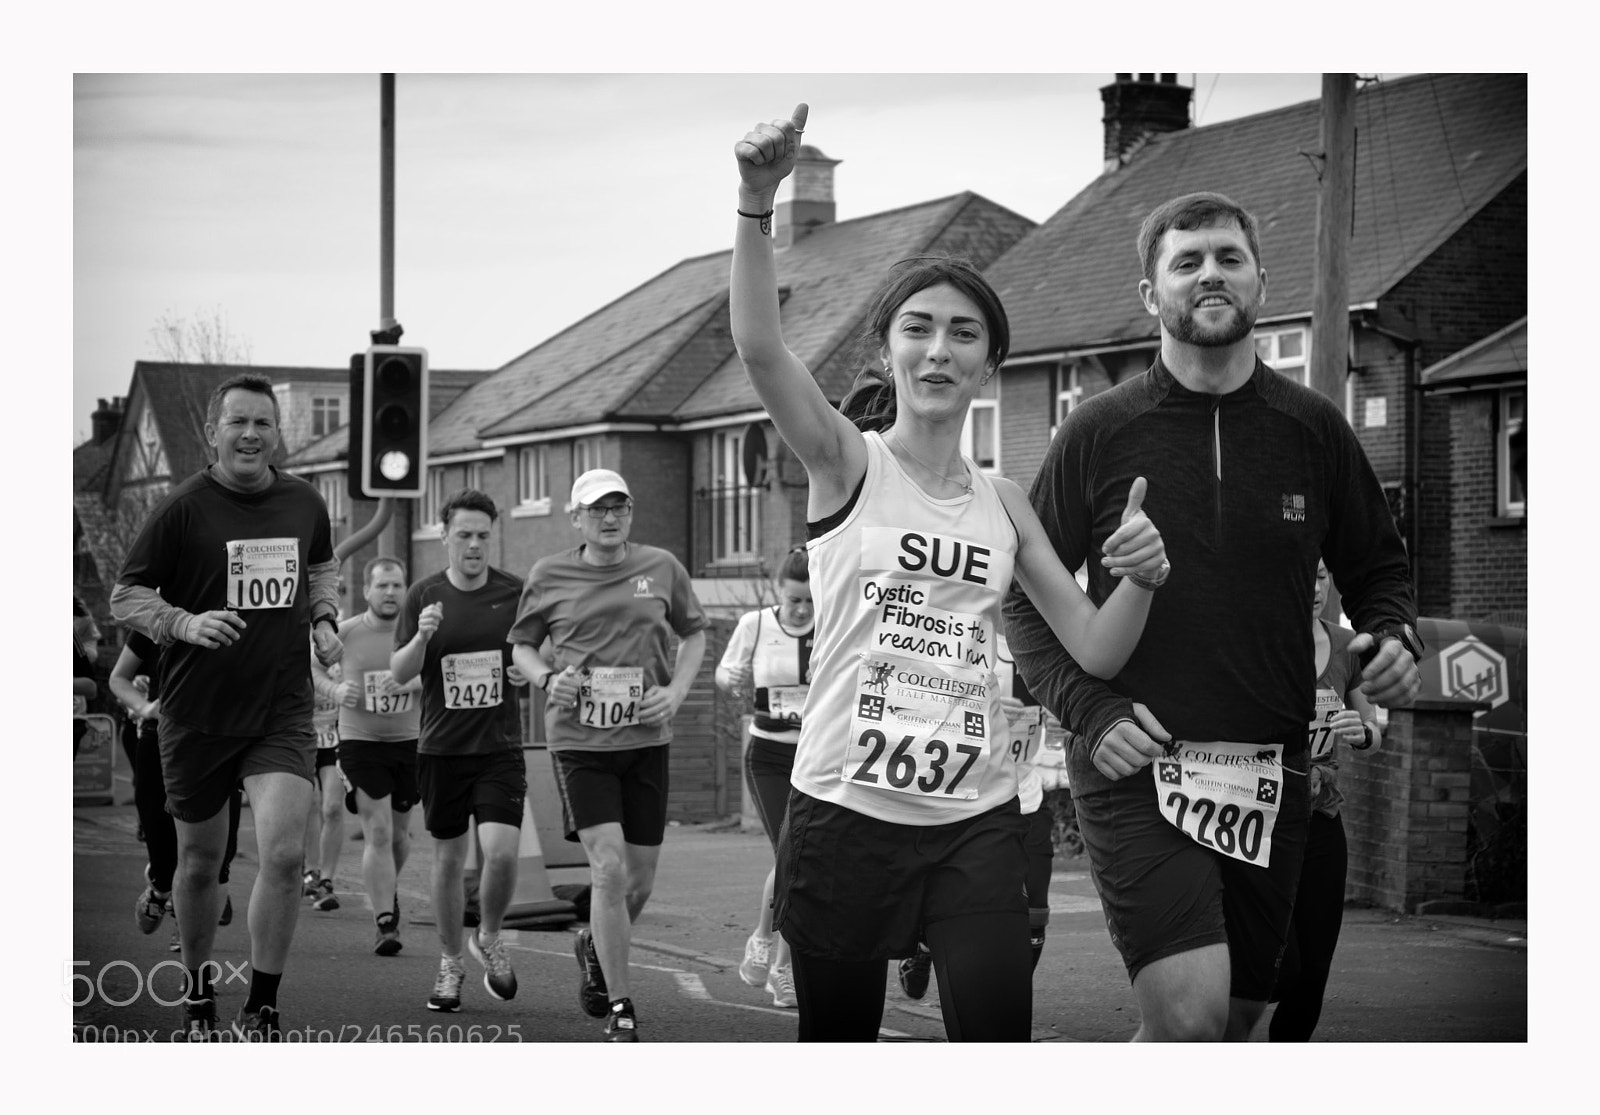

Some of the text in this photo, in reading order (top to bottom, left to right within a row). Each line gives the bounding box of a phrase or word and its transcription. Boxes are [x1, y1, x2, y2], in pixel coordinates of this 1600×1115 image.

[1283, 512, 1305, 522] RUN
[246, 544, 296, 553] COLCHESTER
[898, 532, 991, 586] SUE
[237, 577, 294, 608] 1002
[864, 581, 925, 606] Cystic
[879, 632, 953, 658] reason
[965, 648, 989, 669] run
[449, 682, 499, 707] 2424
[897, 671, 987, 698] COLCHESTER
[897, 688, 926, 700] HALF
[372, 693, 410, 713] 1377
[585, 701, 635, 726] 2104
[897, 713, 928, 725] GRIFFIN
[928, 718, 961, 729] CHMAN
[320, 733, 335, 748] 19
[1012, 739, 1031, 763] 91
[1309, 727, 1332, 755] 77
[851, 728, 982, 795] 2637
[1195, 777, 1223, 788] GRIFFIN
[1223, 782, 1255, 795] CHAPMAN
[1166, 791, 1264, 862] 2280
